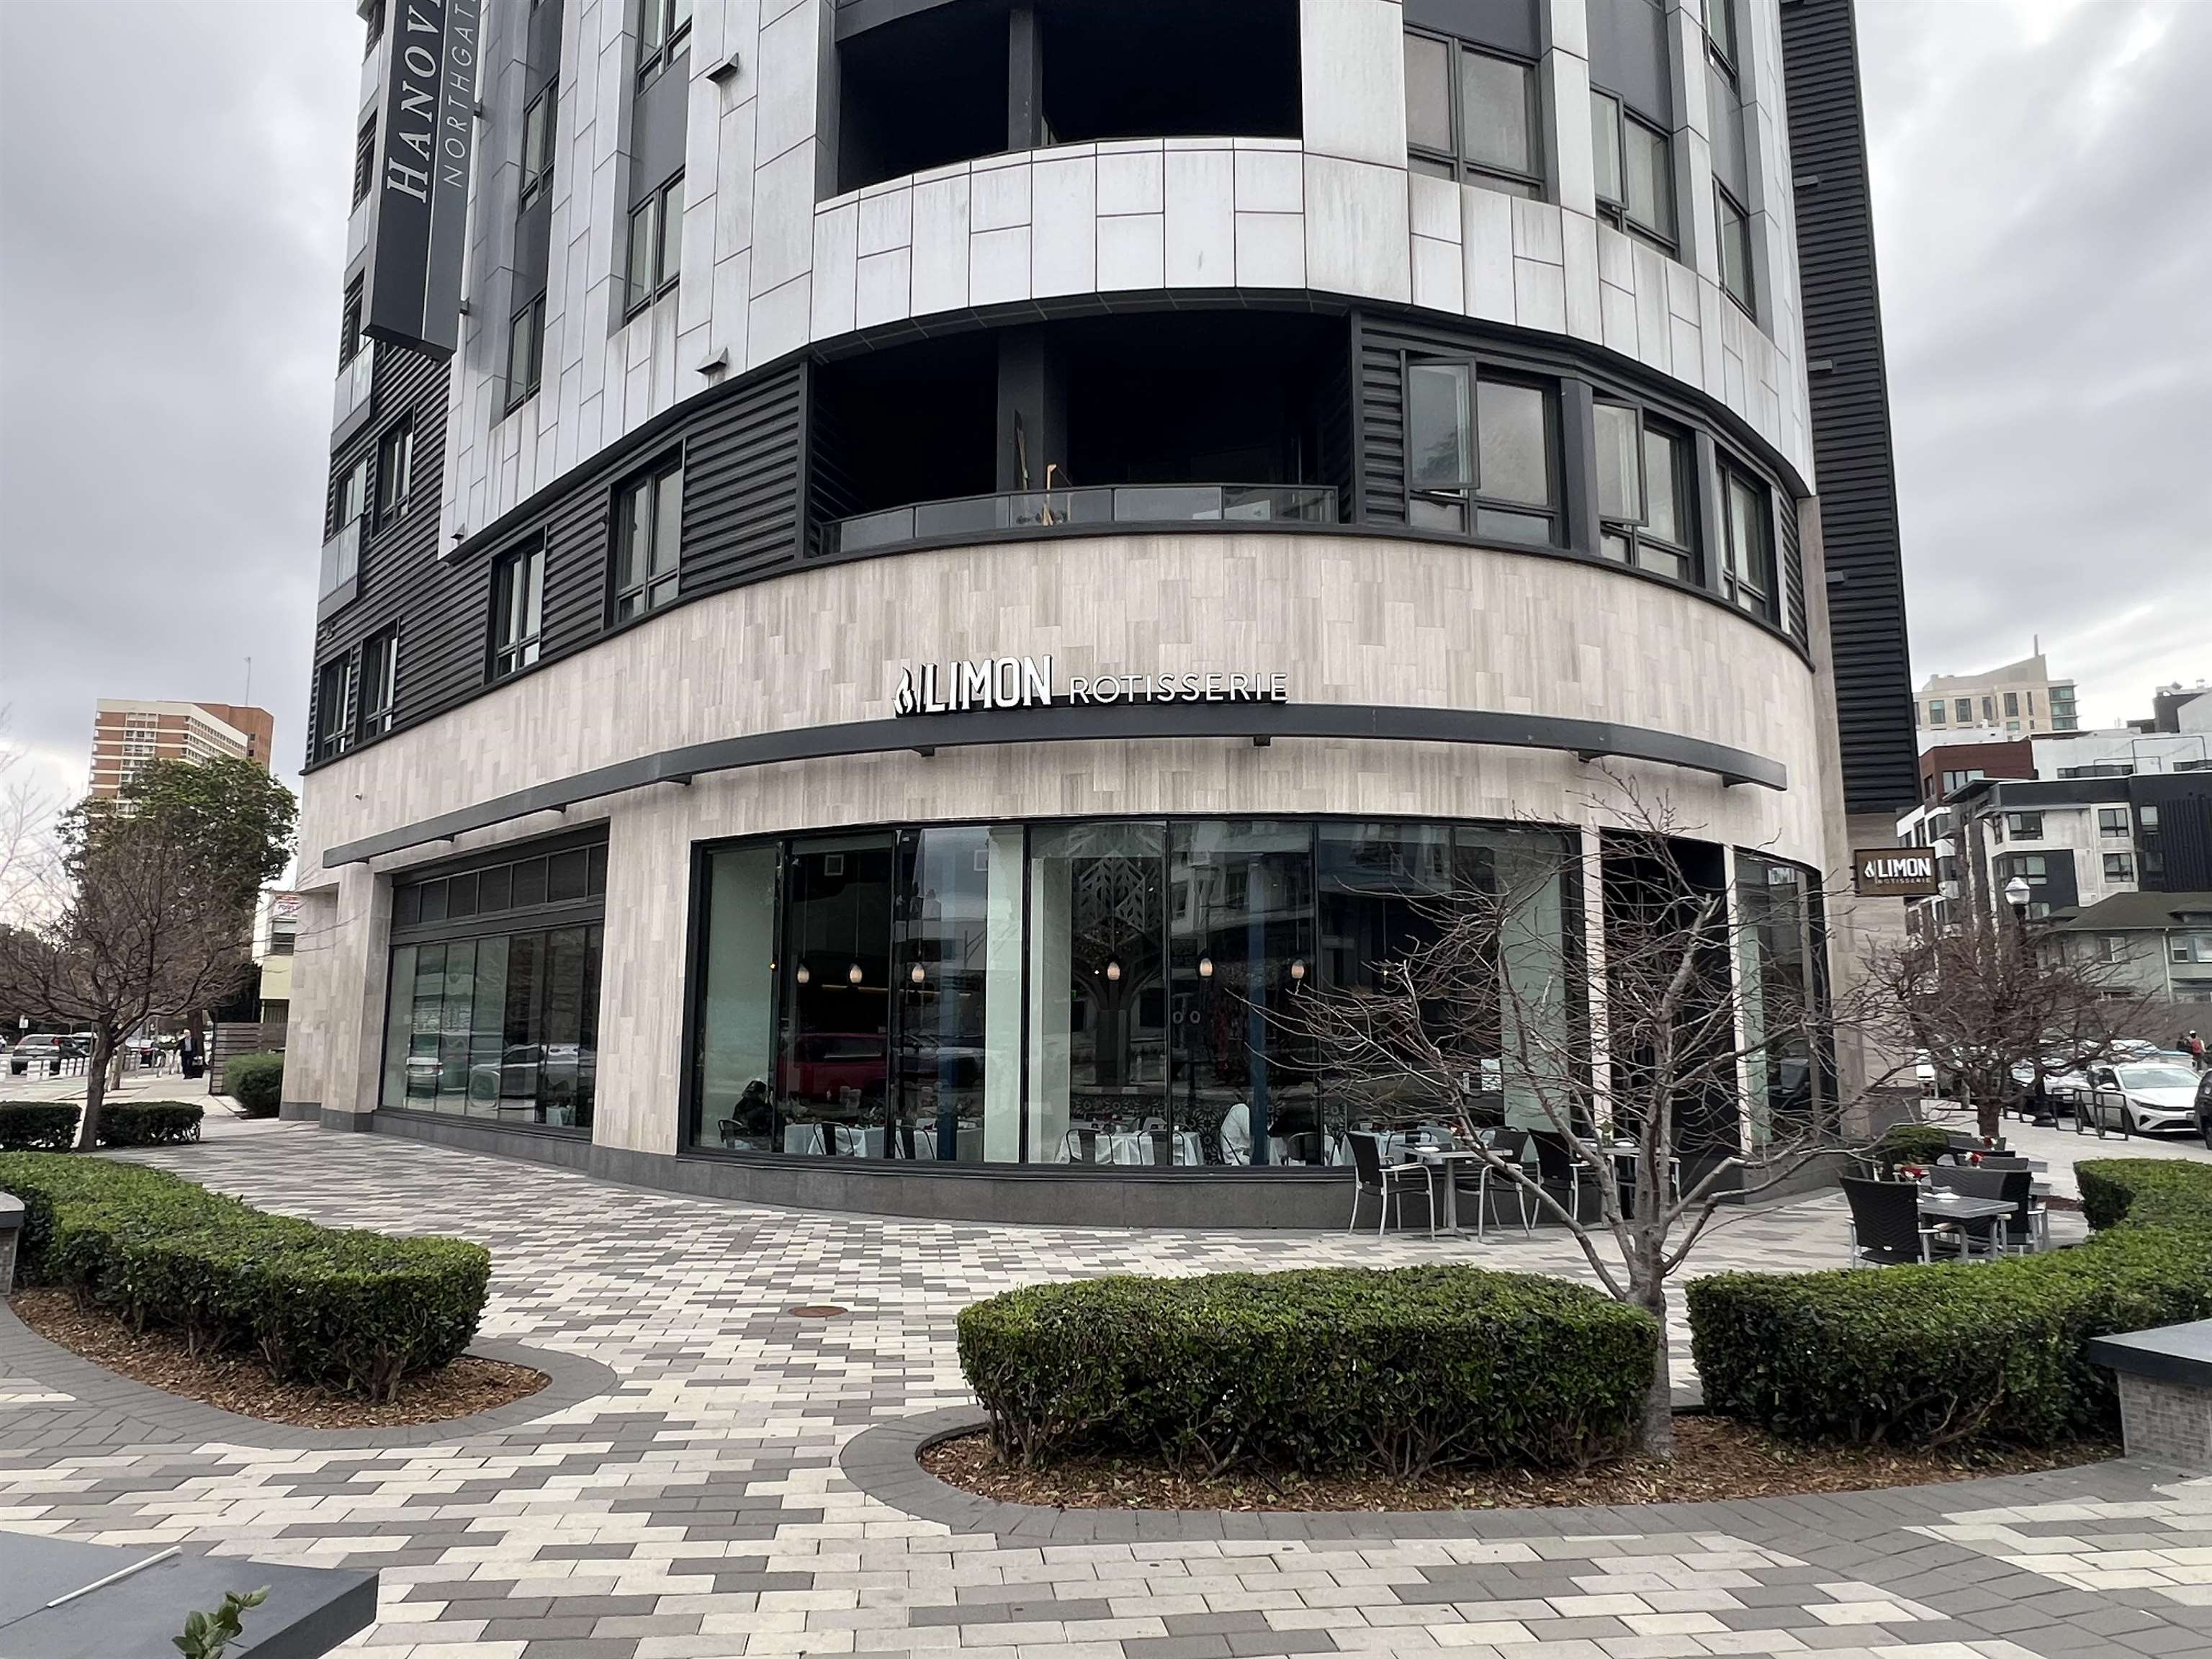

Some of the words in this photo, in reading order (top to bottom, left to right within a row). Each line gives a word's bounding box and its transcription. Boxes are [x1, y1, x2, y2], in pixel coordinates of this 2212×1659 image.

[387, 0, 441, 204] HANOV
[444, 0, 477, 188] NORTHGAT
[925, 655, 1053, 712] LIMON
[1069, 673, 1289, 705] ROTISSERIE
[1876, 857, 1931, 878] LIMON
